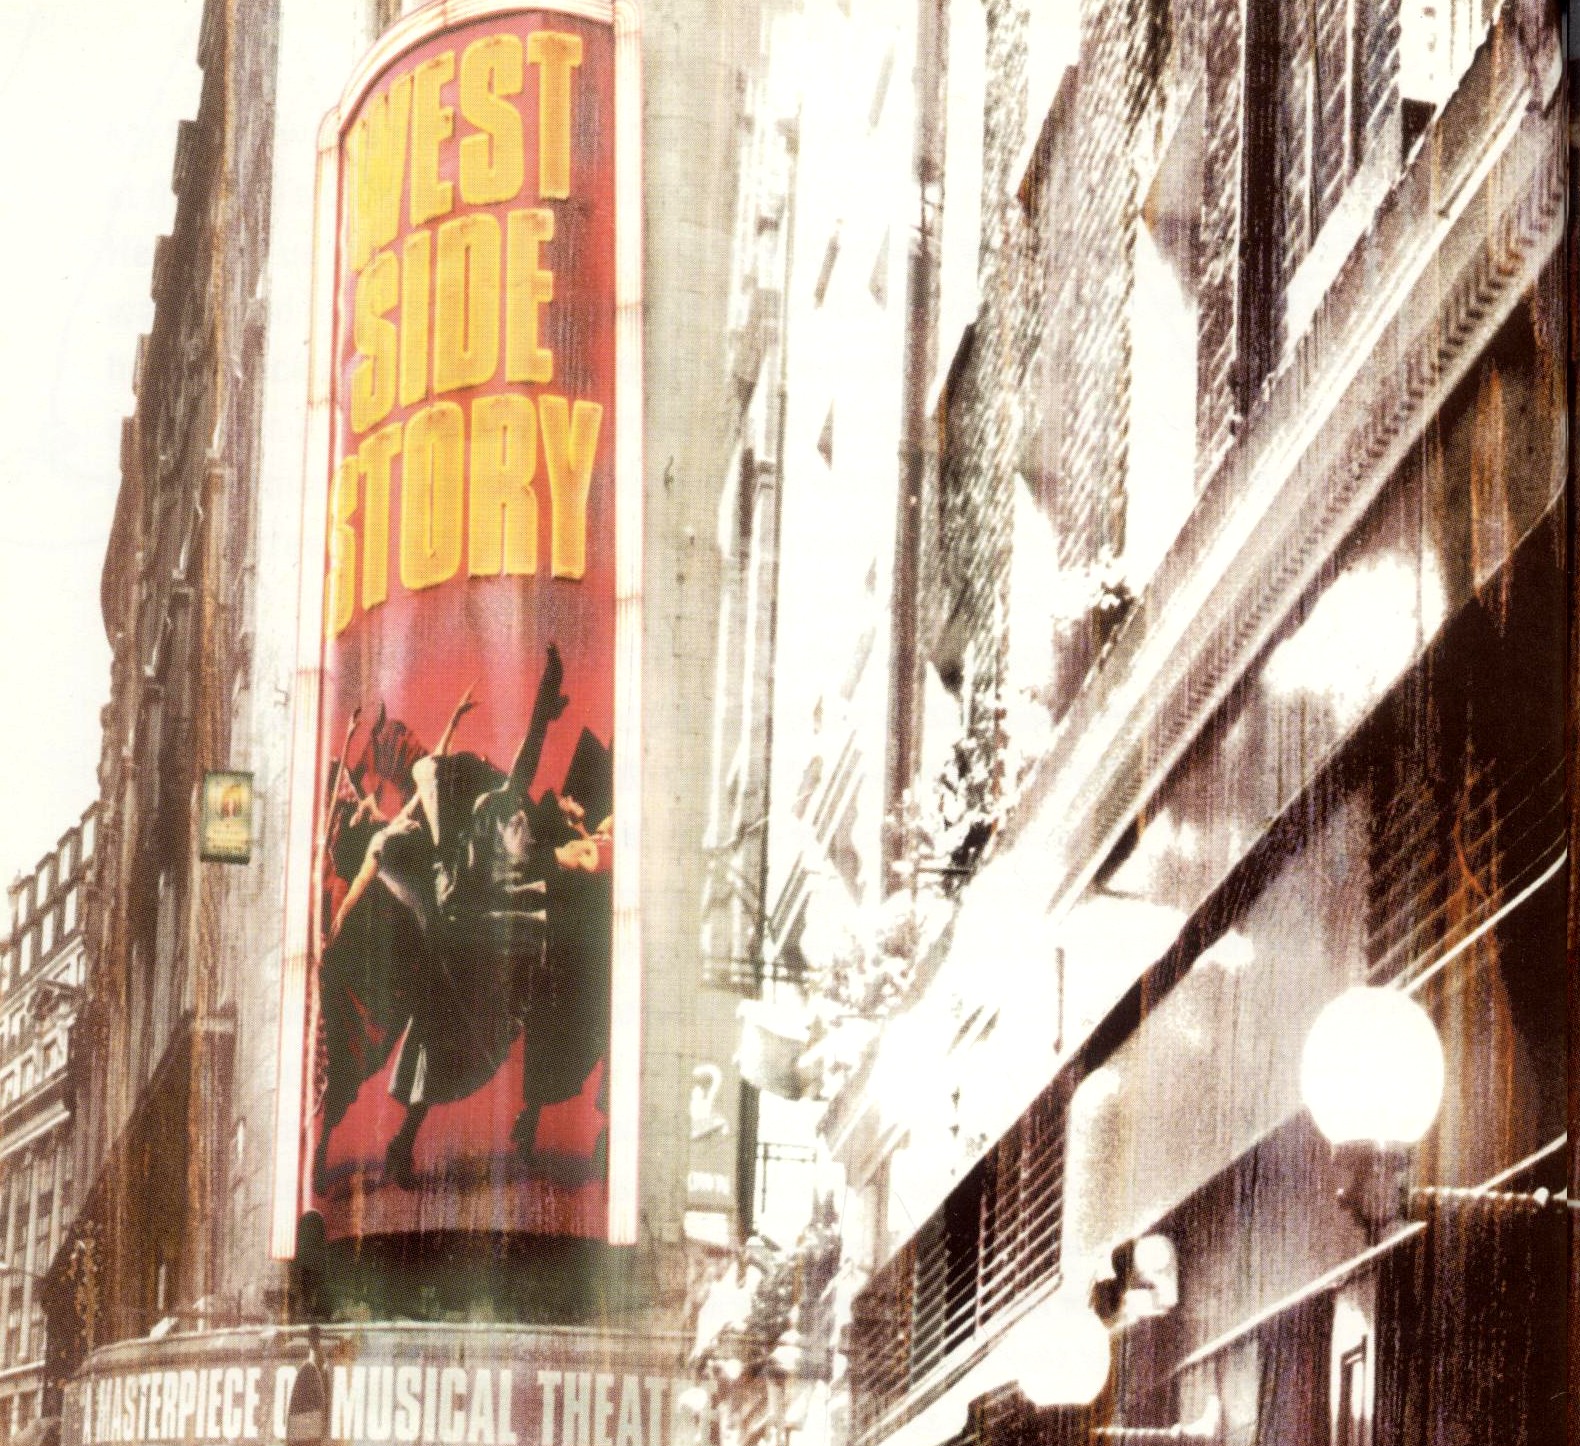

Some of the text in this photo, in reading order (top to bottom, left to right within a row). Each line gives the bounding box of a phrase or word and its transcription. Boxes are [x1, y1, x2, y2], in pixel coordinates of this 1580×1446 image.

[345, 30, 582, 273] WEST
[350, 208, 554, 433] SIDE
[325, 393, 603, 639] STORY
[95, 1367, 262, 1443] MASTERPIECE
[330, 1365, 517, 1446] MUSICAL
